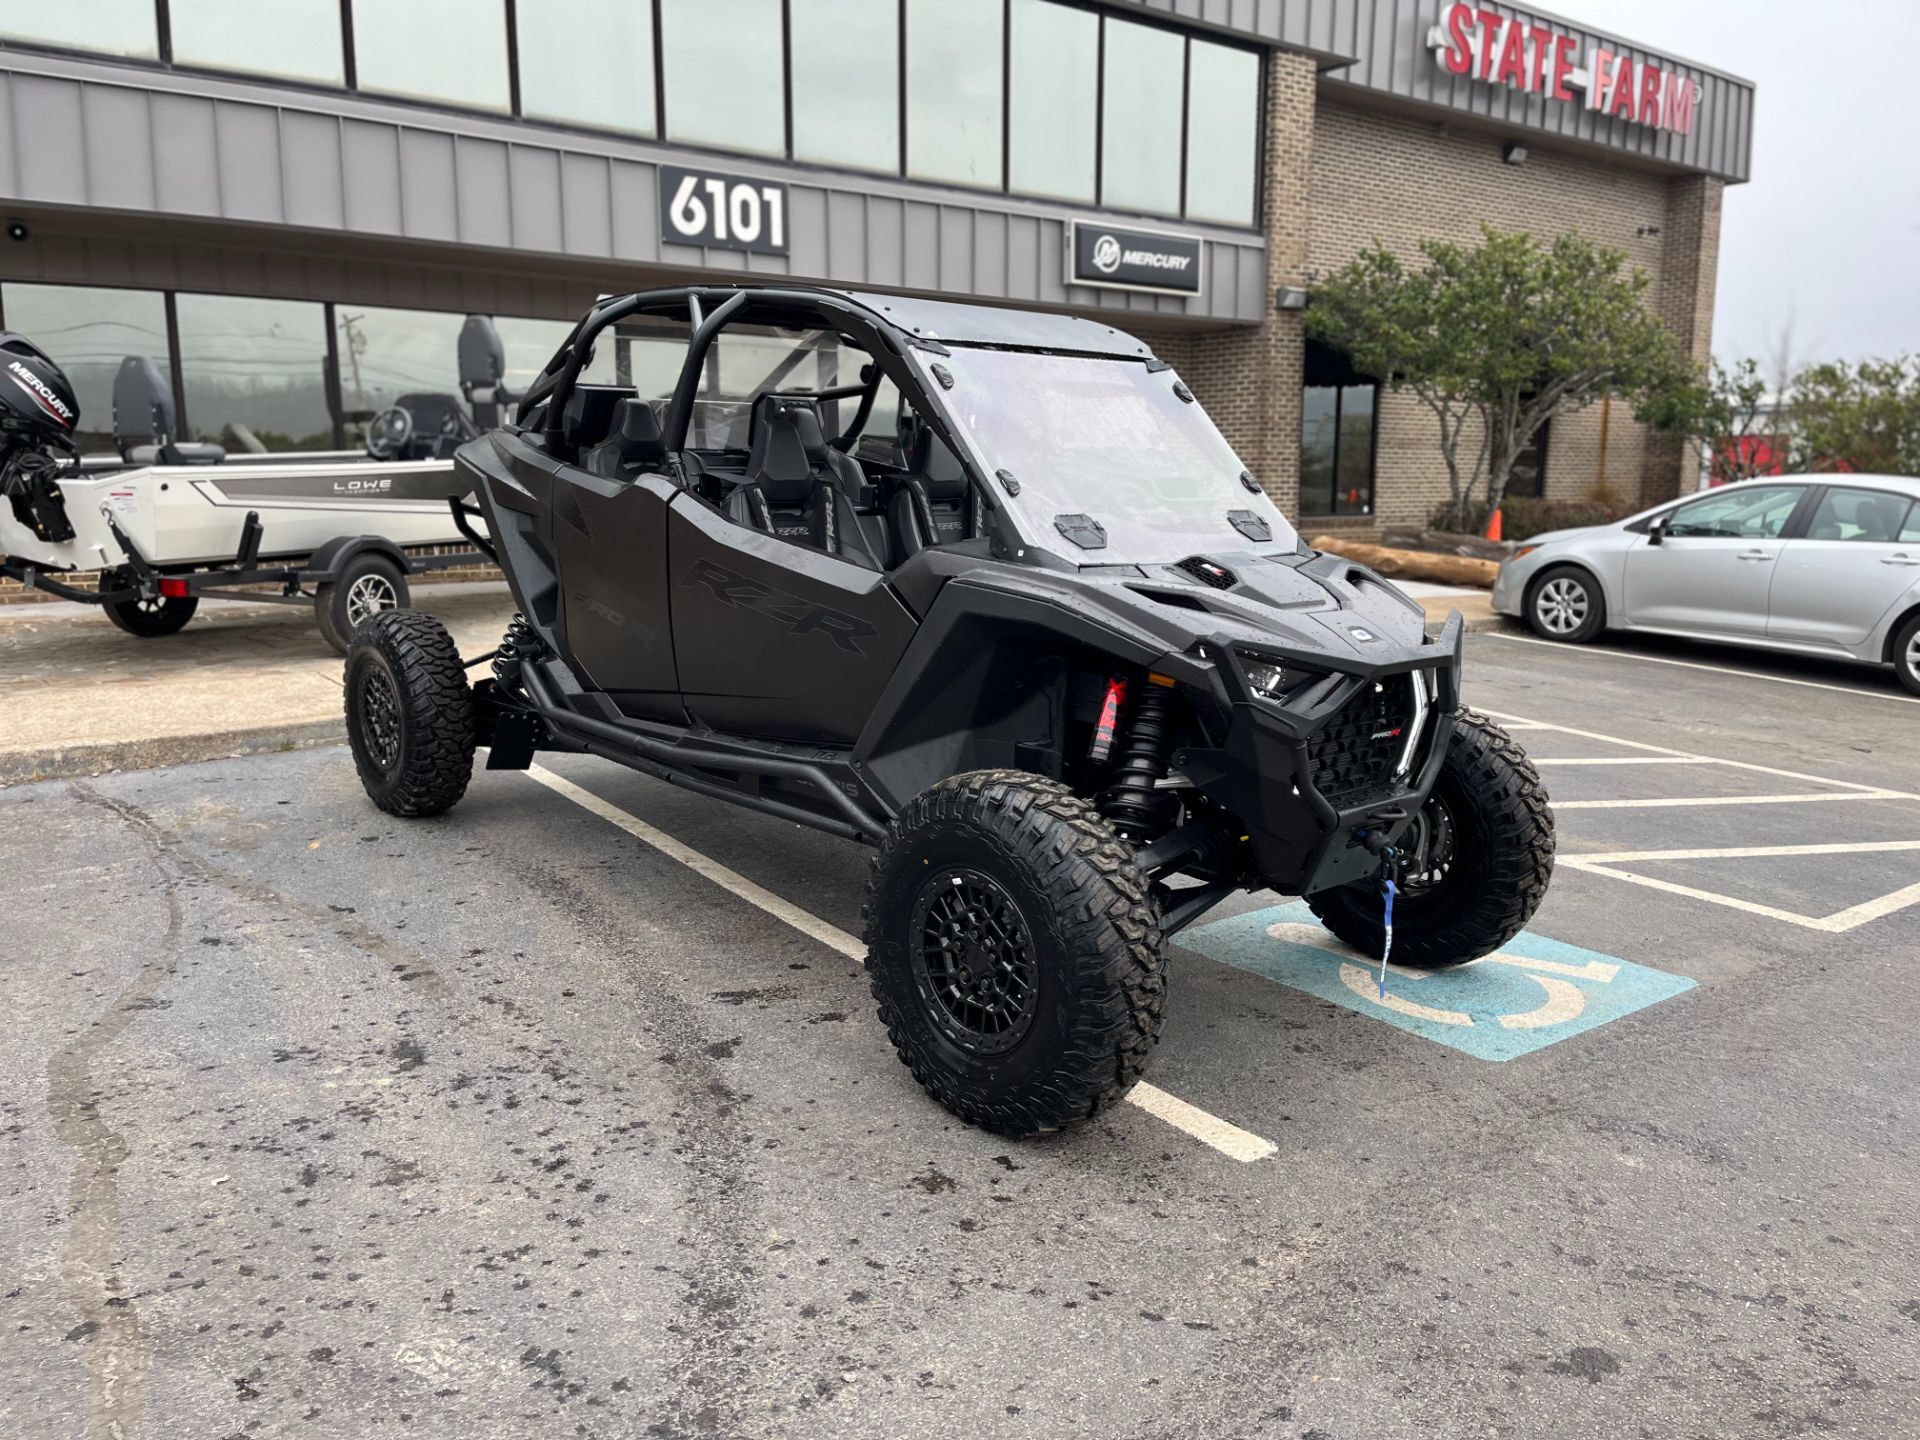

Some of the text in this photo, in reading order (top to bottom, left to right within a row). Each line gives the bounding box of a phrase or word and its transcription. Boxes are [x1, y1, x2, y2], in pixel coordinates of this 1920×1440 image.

[1440, 3, 1696, 136] STATE FARM
[669, 175, 784, 247] 6101
[1122, 250, 1191, 270] MERCURY
[8, 361, 73, 419] MERCURY
[333, 479, 393, 491] LOWE
[677, 557, 881, 658] RZR
